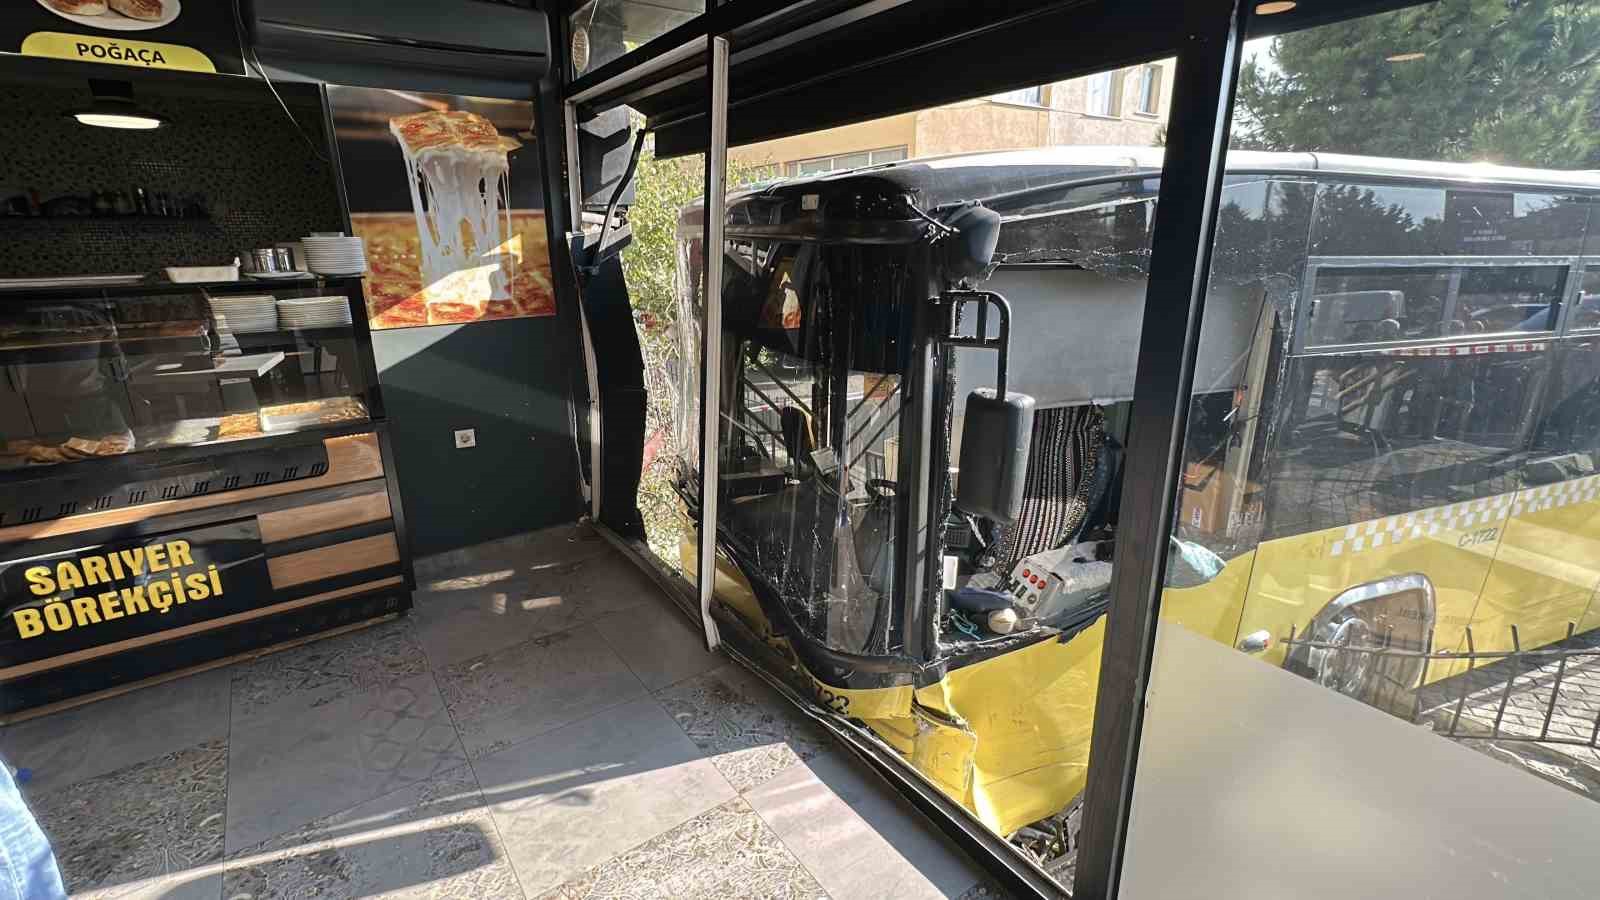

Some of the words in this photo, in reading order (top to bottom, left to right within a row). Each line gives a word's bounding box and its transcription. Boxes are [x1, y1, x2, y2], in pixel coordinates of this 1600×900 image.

[76, 42, 165, 65] POĞAÇA
[24, 540, 194, 596] SARIYER
[13, 564, 223, 639] BÖREKÇİSİ
